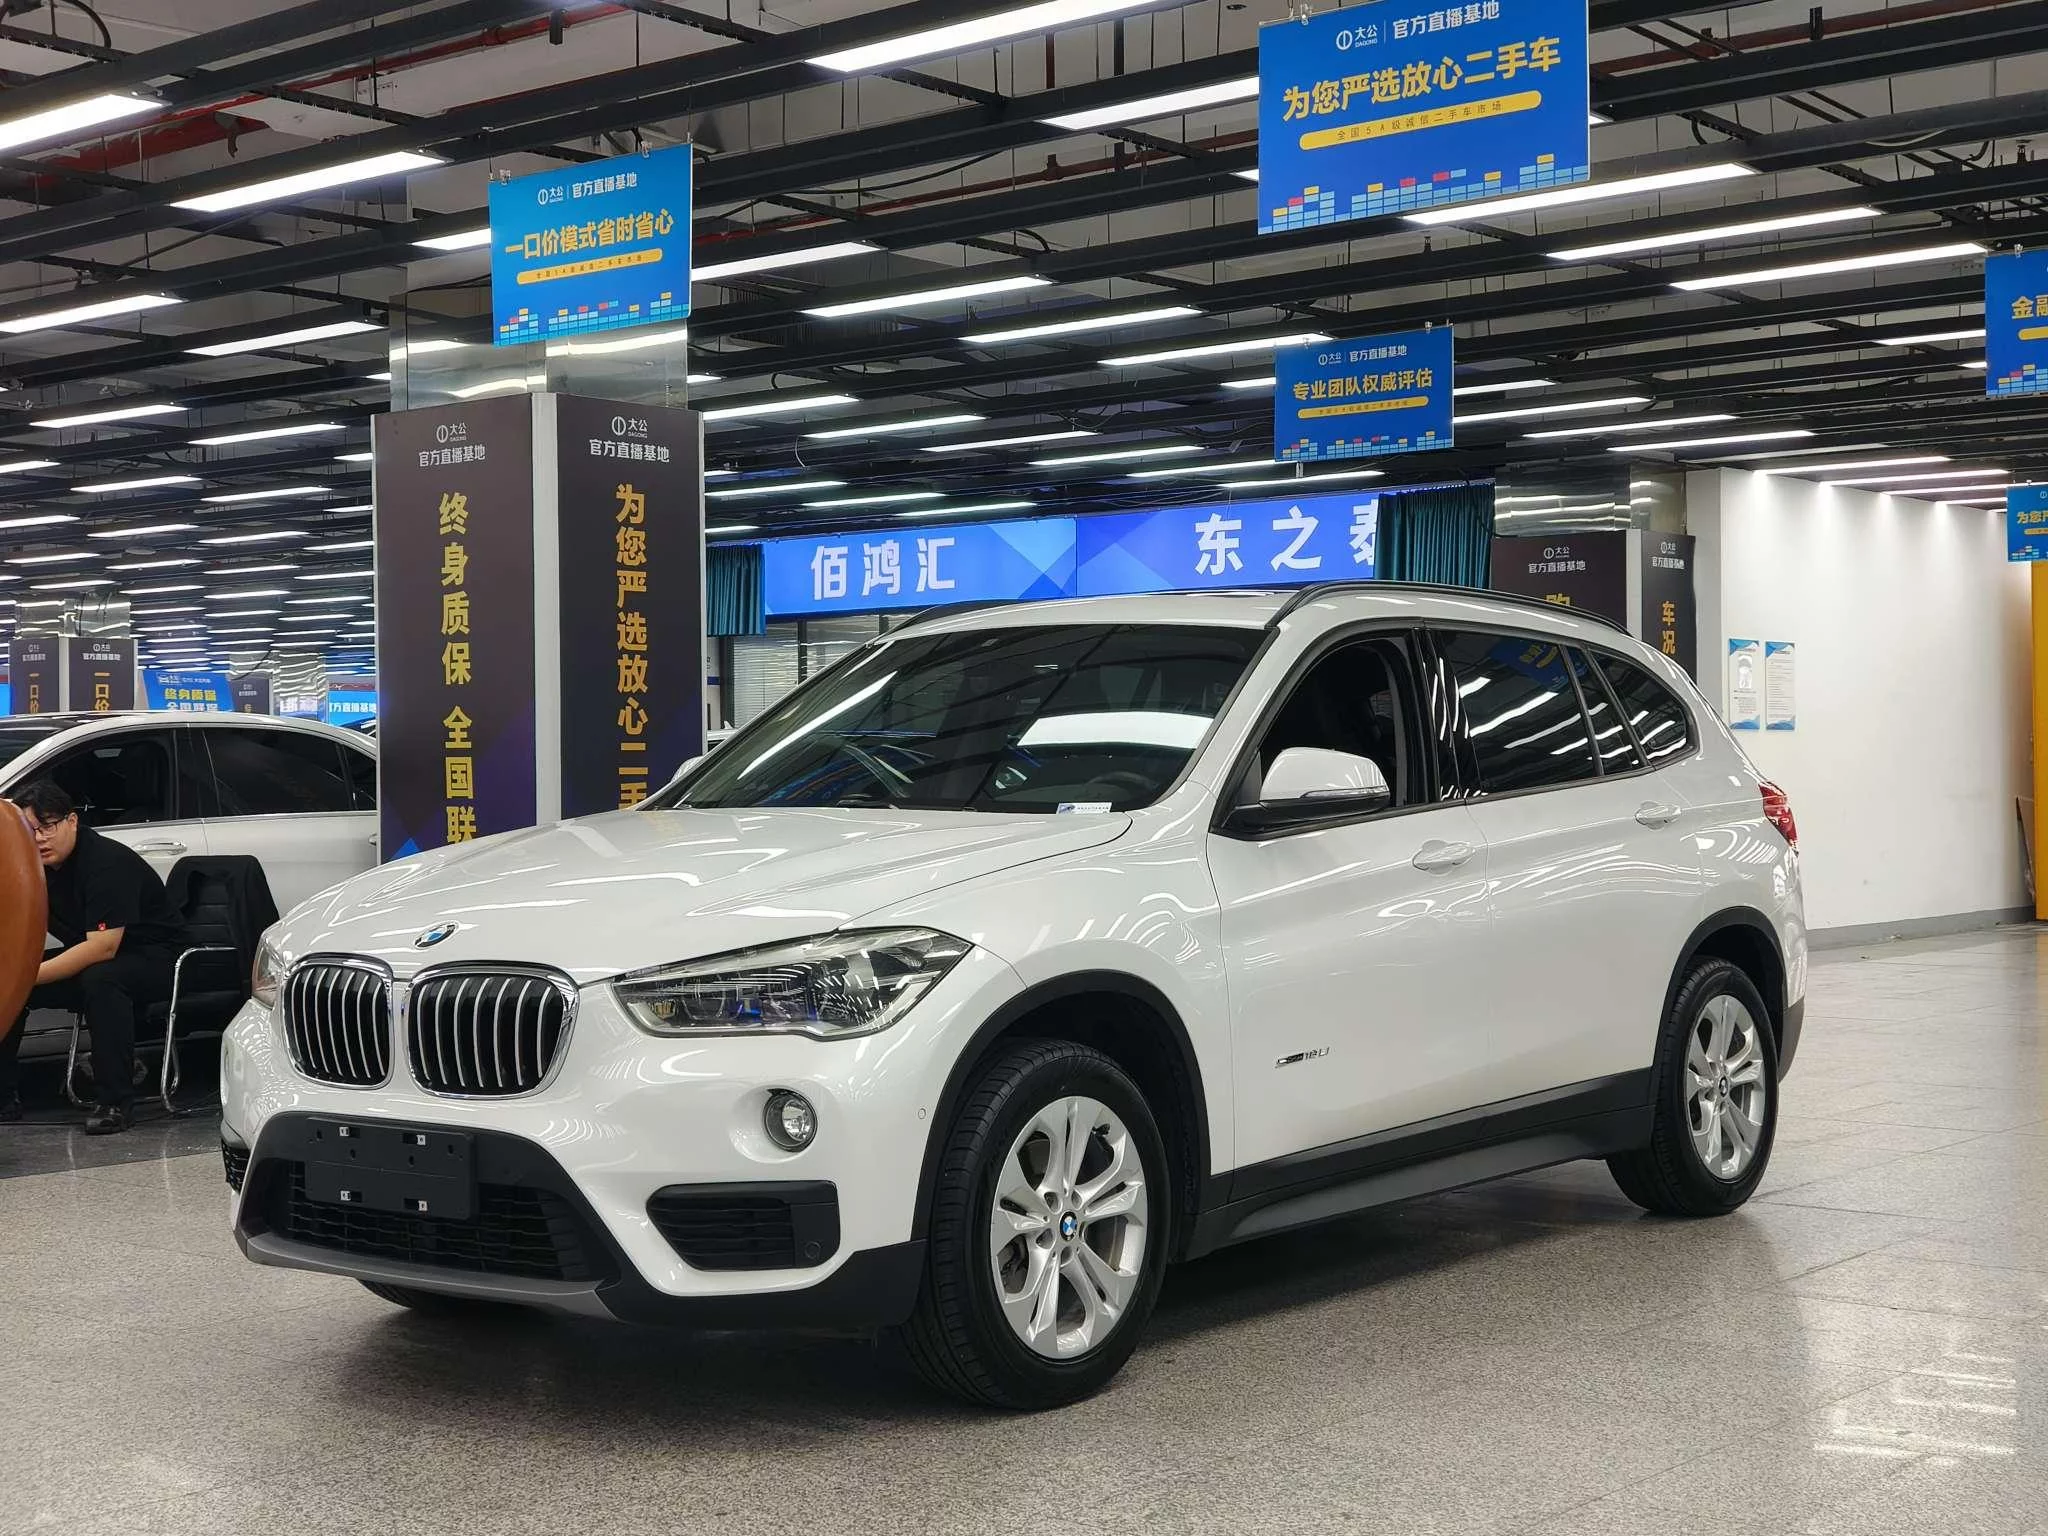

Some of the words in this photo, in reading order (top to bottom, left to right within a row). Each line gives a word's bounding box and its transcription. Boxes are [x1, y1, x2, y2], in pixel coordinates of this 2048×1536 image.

[1354, 24, 1378, 41] 大公
[1392, 0, 1500, 40] 官方直播基地
[1283, 37, 1561, 121] 为您严选放心二手车
[549, 186, 563, 197] 大公
[572, 172, 637, 198] 官方直播基地
[505, 208, 674, 259] 一口价模式省时省心
[1293, 367, 1433, 400] 专业团队权威评估
[449, 422, 467, 436] 大公
[627, 418, 648, 432] 大公
[418, 443, 485, 467] 官方直播基地
[589, 438, 670, 463] 官方直播基地
[811, 537, 957, 601] 佰鸿汇
[1528, 560, 1586, 574] 官方直播基地
